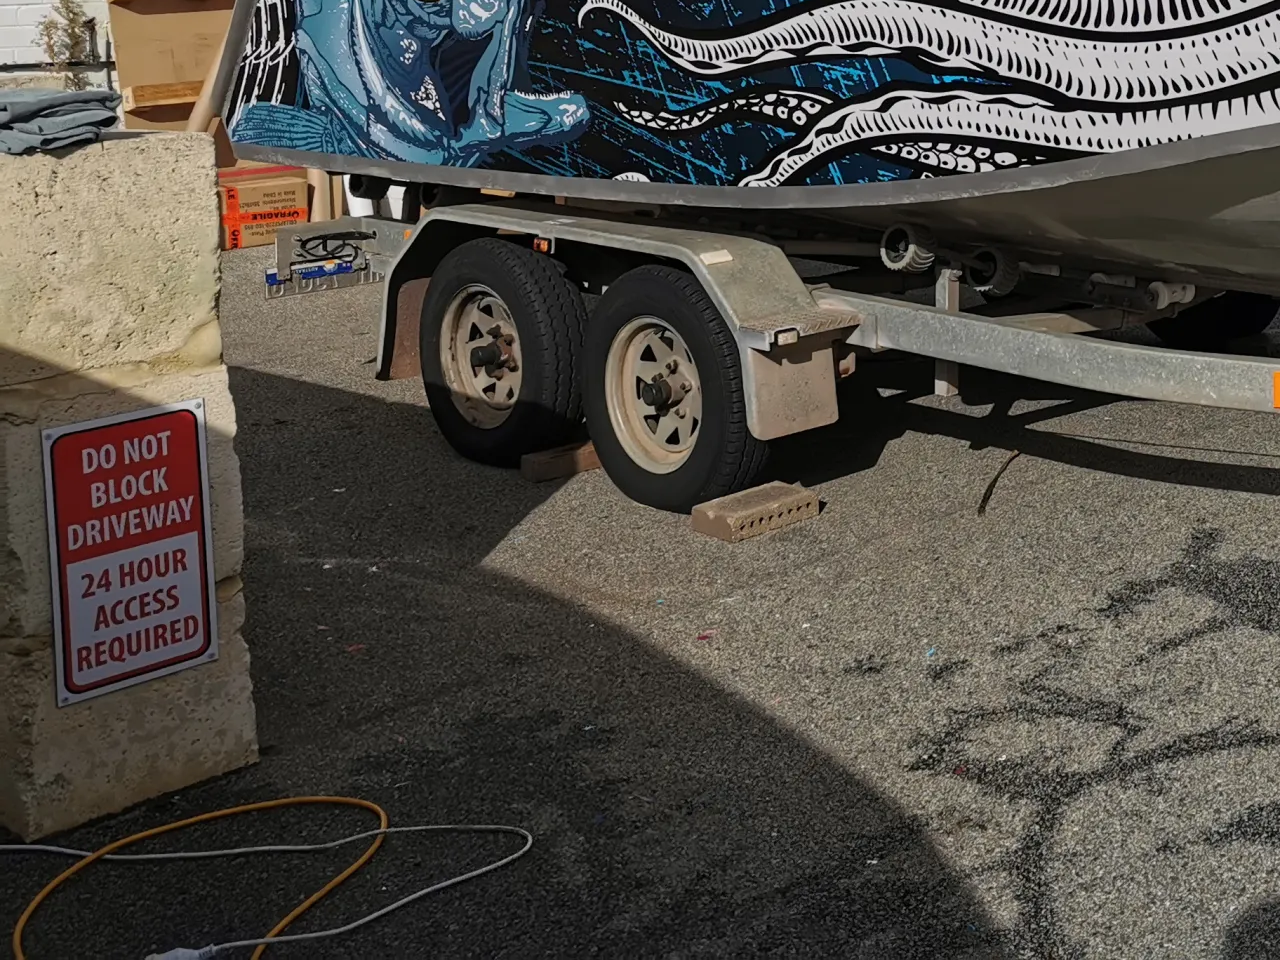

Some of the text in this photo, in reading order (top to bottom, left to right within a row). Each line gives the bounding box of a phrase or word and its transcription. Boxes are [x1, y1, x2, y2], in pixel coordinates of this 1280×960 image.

[251, 212, 291, 221] FRAGILE
[81, 431, 171, 474] DO NOT
[90, 467, 169, 508] BLOCK
[67, 495, 194, 551] DRIVEWAY
[81, 548, 188, 599] 24 HOUR
[93, 585, 180, 632] ACCESS
[76, 615, 199, 673] REQUIRED
